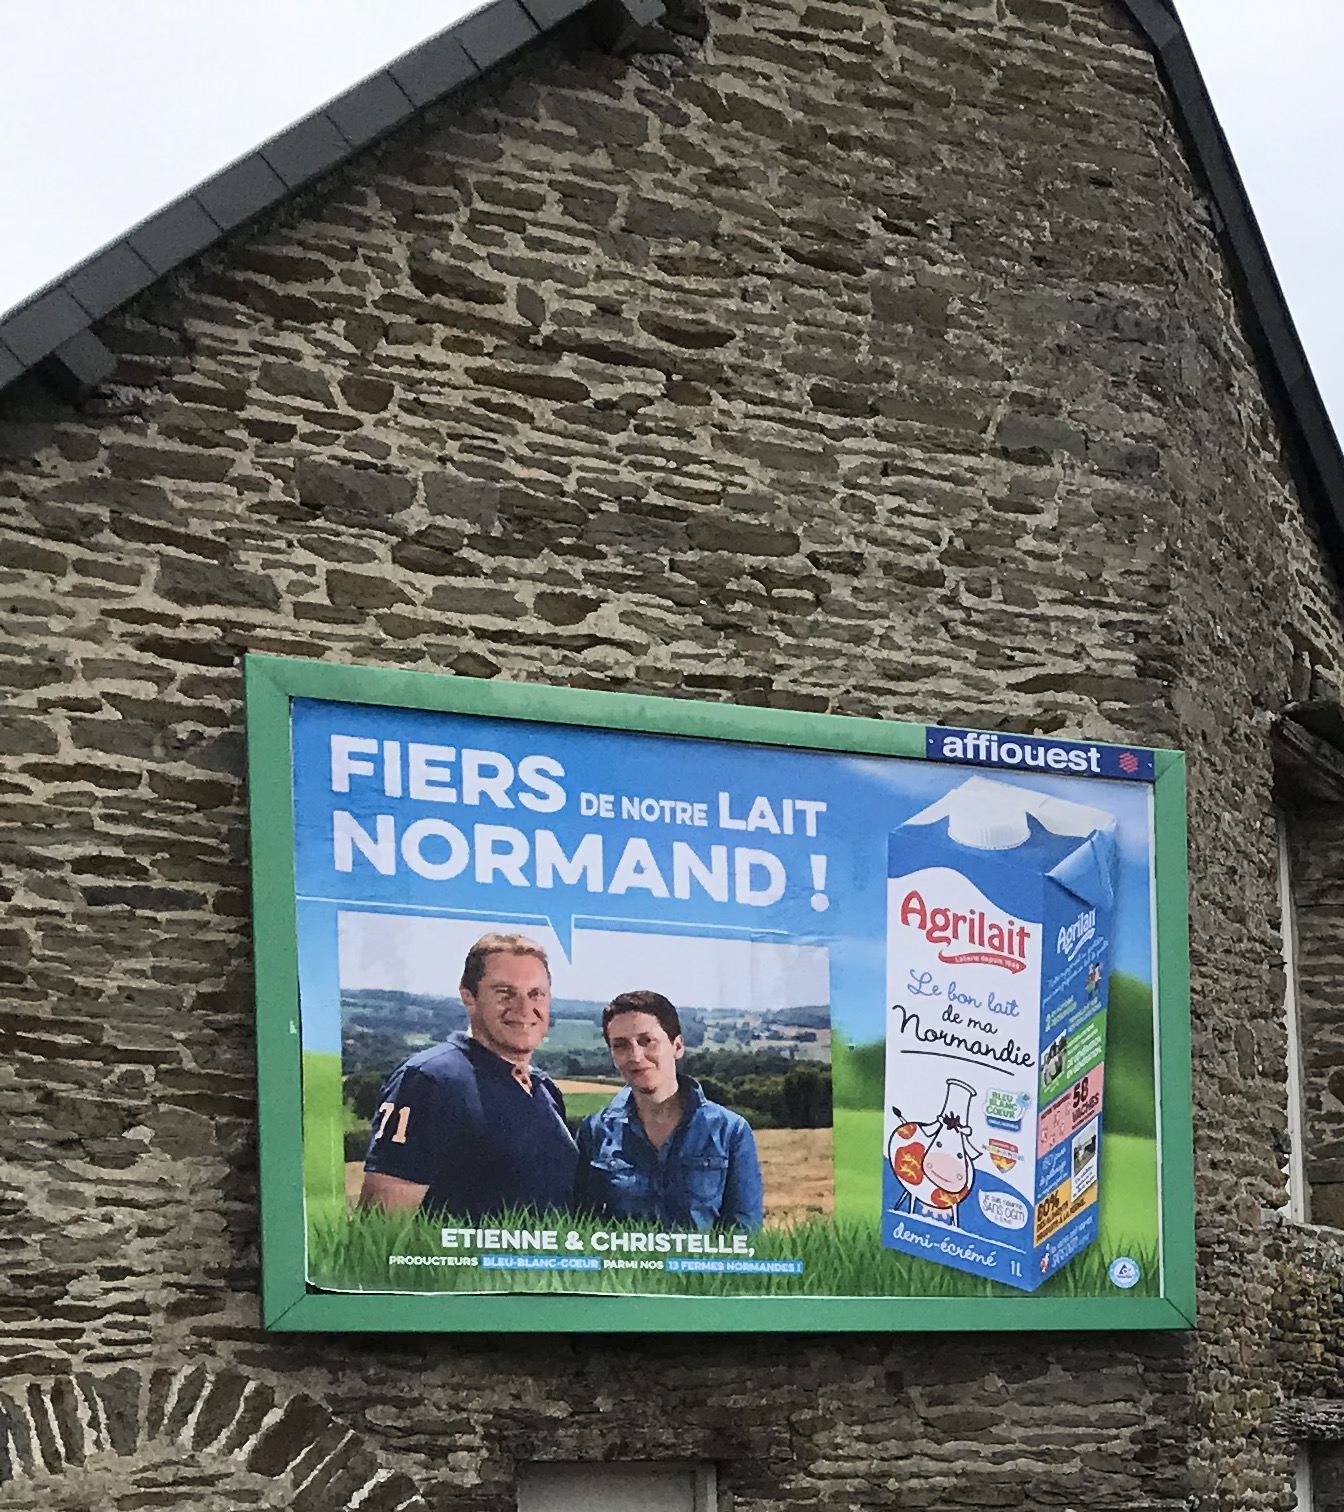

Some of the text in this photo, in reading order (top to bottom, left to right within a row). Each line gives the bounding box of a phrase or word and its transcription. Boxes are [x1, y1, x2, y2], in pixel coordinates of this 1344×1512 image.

[942, 733, 1100, 773] affiouest
[330, 734, 827, 837] FIERS DE NOTRE LAIT
[333, 810, 787, 907] NORMAND
[901, 890, 1031, 958] Agrilait
[907, 969, 942, 996] Le
[947, 981, 982, 1008] bon
[987, 992, 1020, 1017] lait
[892, 1004, 1035, 1067] Normandie
[942, 1004, 998, 1035] de ma
[989, 1098, 1017, 1111] BLANC
[1073, 1077, 1088, 1108] 58
[375, 1102, 410, 1144] 71
[441, 1228, 755, 1257] ETIENNE & CHRISTELLE,
[893, 1221, 997, 1267] demi-écrémé
[389, 1255, 478, 1267] PRODUCTEURS
[604, 1259, 638, 1269] PARMI
[640, 1260, 664, 1270] NOS
[668, 1261, 679, 1270] 13
[681, 1261, 724, 1271] FERMES
[726, 1262, 794, 1273] NORMANDES
